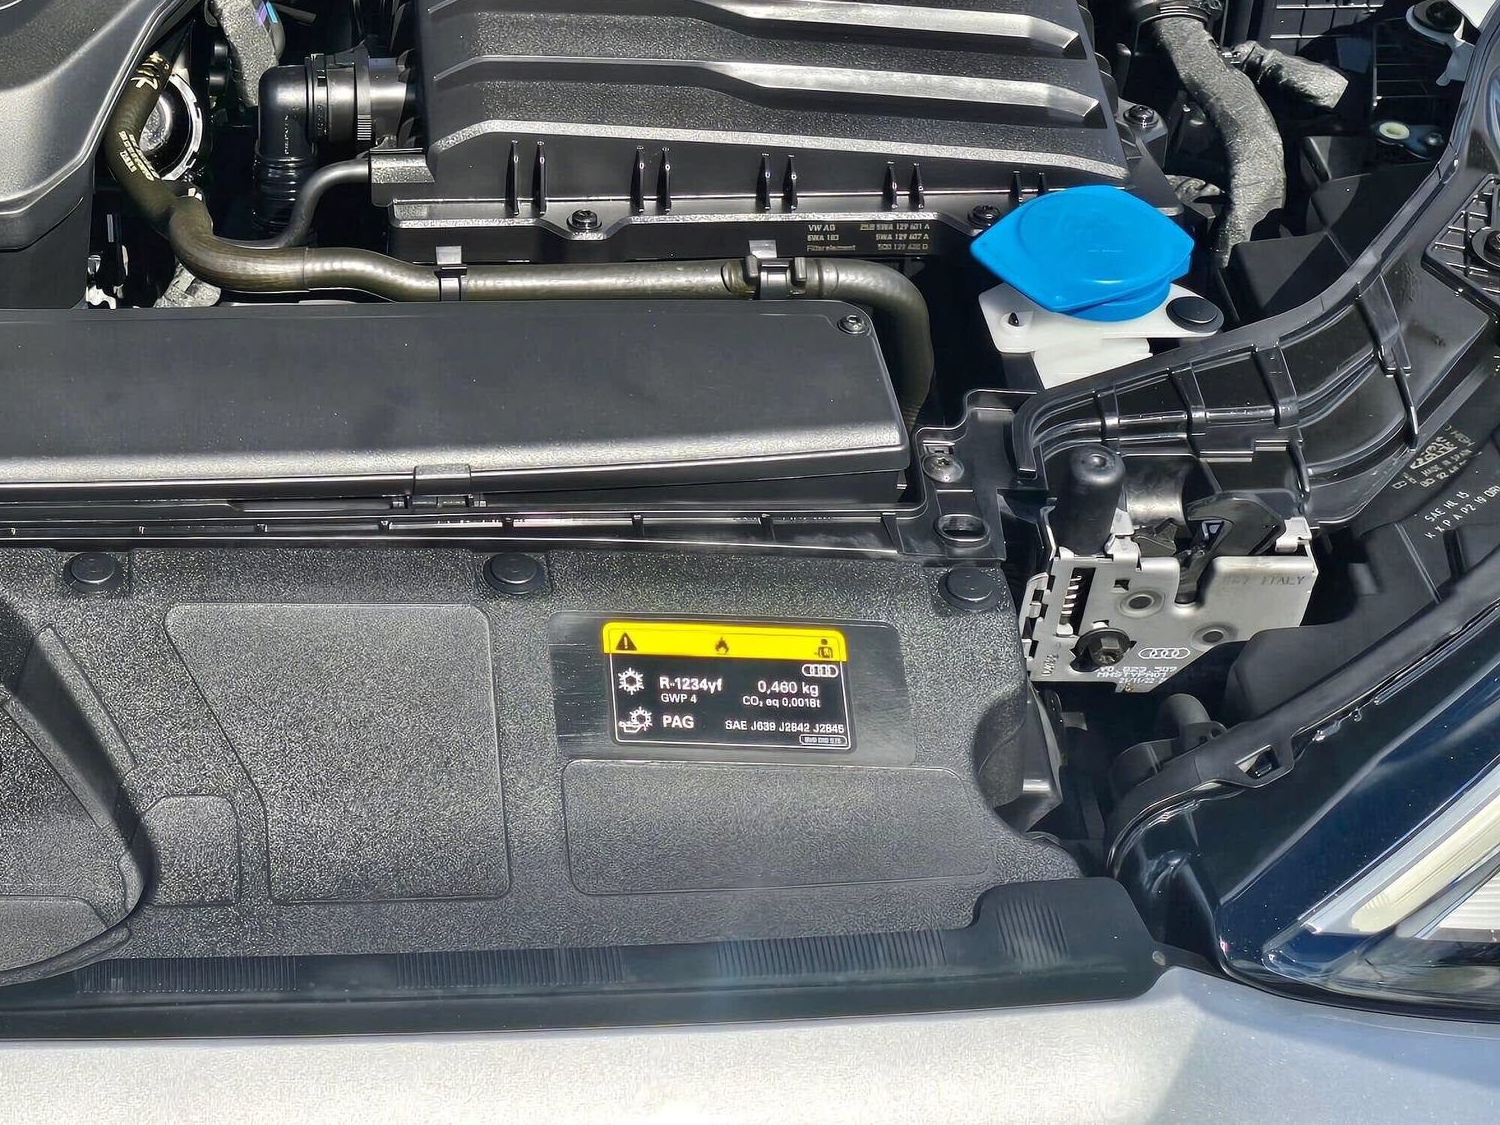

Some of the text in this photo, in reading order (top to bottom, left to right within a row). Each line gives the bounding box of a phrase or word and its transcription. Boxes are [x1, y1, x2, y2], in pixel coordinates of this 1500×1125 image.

[1424, 508, 1446, 522] SAE
[1456, 491, 1470, 499] 15
[1260, 576, 1305, 586] ITALY
[659, 676, 722, 694] R-1234yf
[802, 681, 819, 697] kg
[660, 694, 688, 703] GWP
[690, 694, 697, 703] 4
[766, 698, 780, 708] eq
[662, 715, 694, 728] PAG
[725, 720, 747, 730] SAE
[750, 721, 776, 732] J639
[778, 722, 810, 733] J2842
